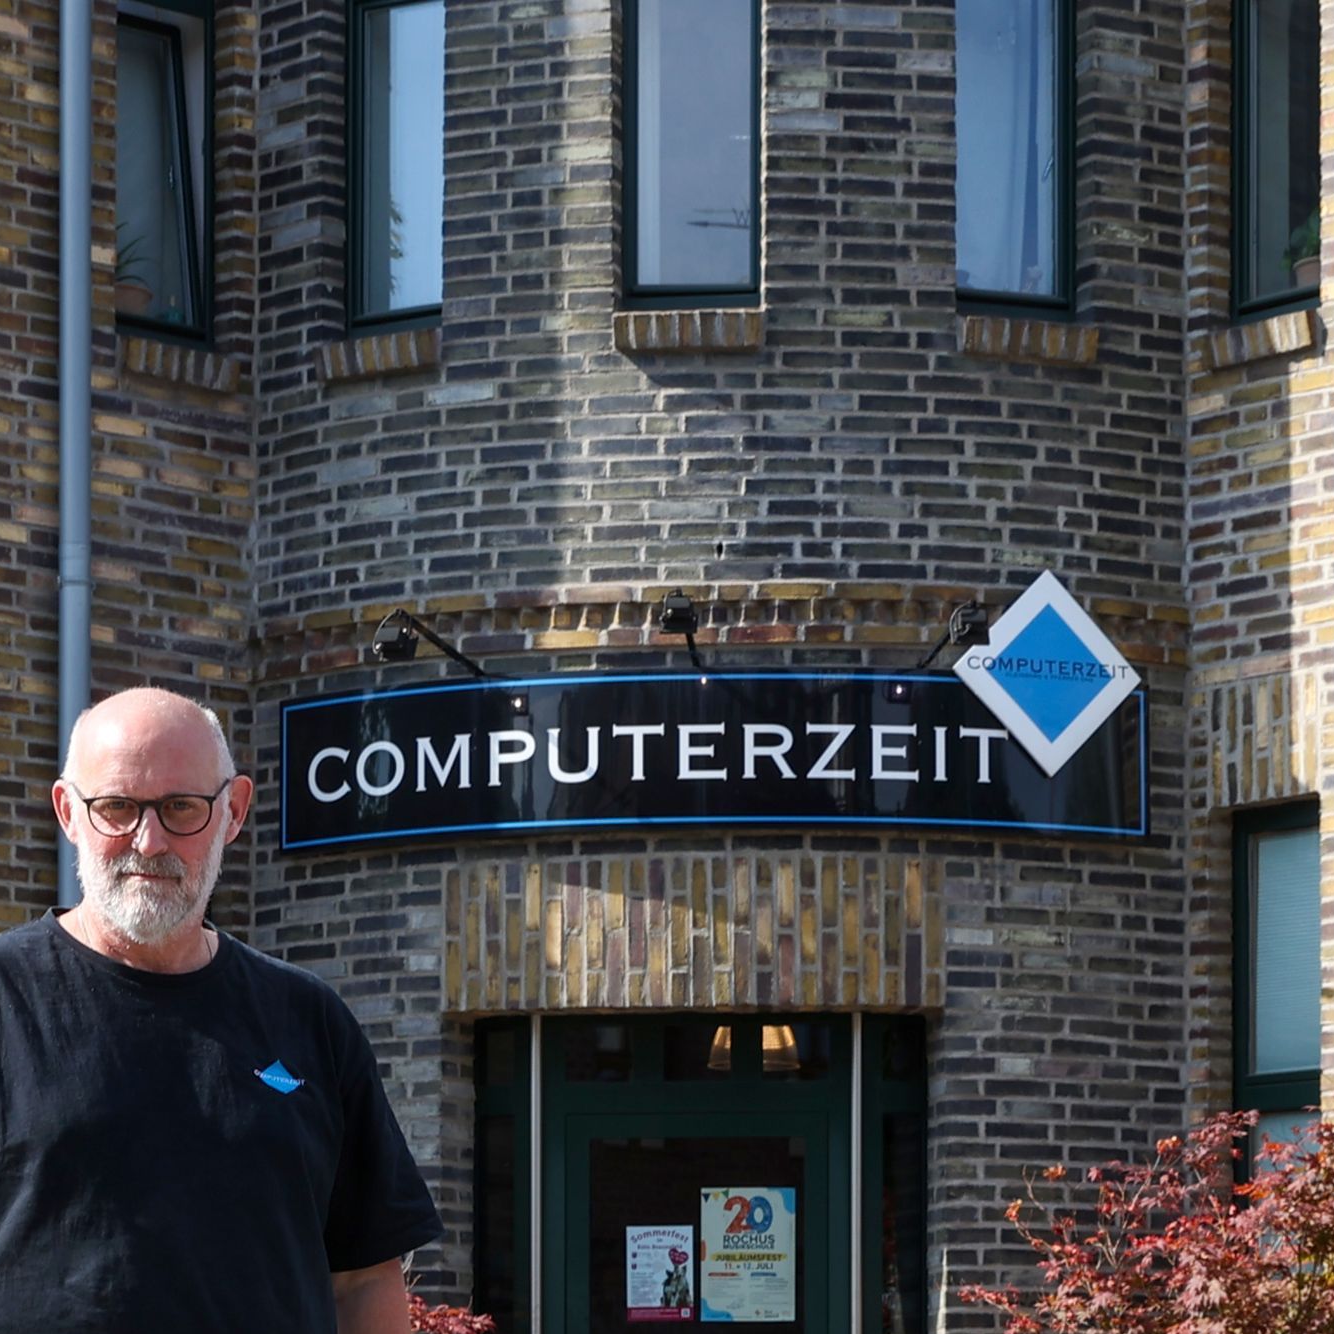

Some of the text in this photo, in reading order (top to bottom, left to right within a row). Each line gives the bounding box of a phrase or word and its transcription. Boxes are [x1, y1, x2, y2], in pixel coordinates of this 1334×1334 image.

[967, 656, 1129, 680] COMPUTERZEIT
[307, 722, 1011, 803] COMPUTERZEIT
[723, 1195, 773, 1234] 20
[630, 1229, 689, 1243] Sommerfest
[723, 1234, 775, 1245] ROCHUS
[715, 1252, 782, 1262] JUBILÄUMSFEST
[755, 1262, 774, 1270] JULI
